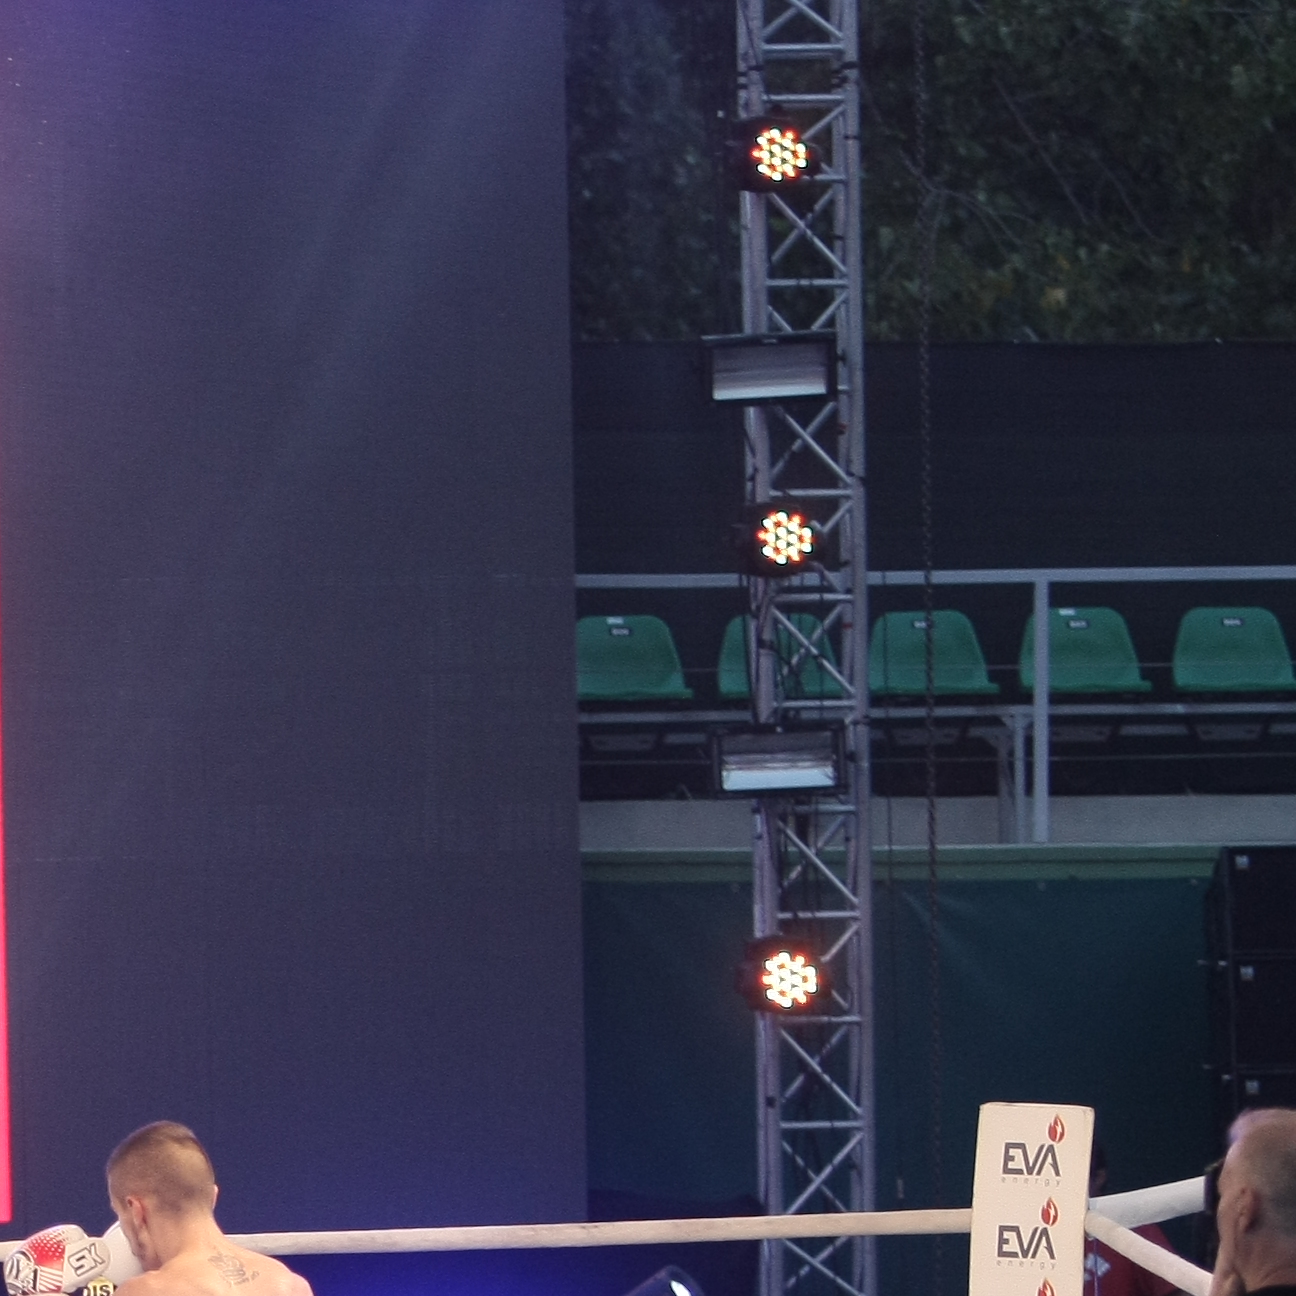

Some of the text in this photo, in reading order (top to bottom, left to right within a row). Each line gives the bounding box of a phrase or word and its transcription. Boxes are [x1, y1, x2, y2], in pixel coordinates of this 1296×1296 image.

[1001, 1142, 1061, 1177] EVA
[1001, 1177, 1061, 1187] energy
[997, 1225, 1056, 1260] EVA
[996, 1260, 1057, 1270] energy
